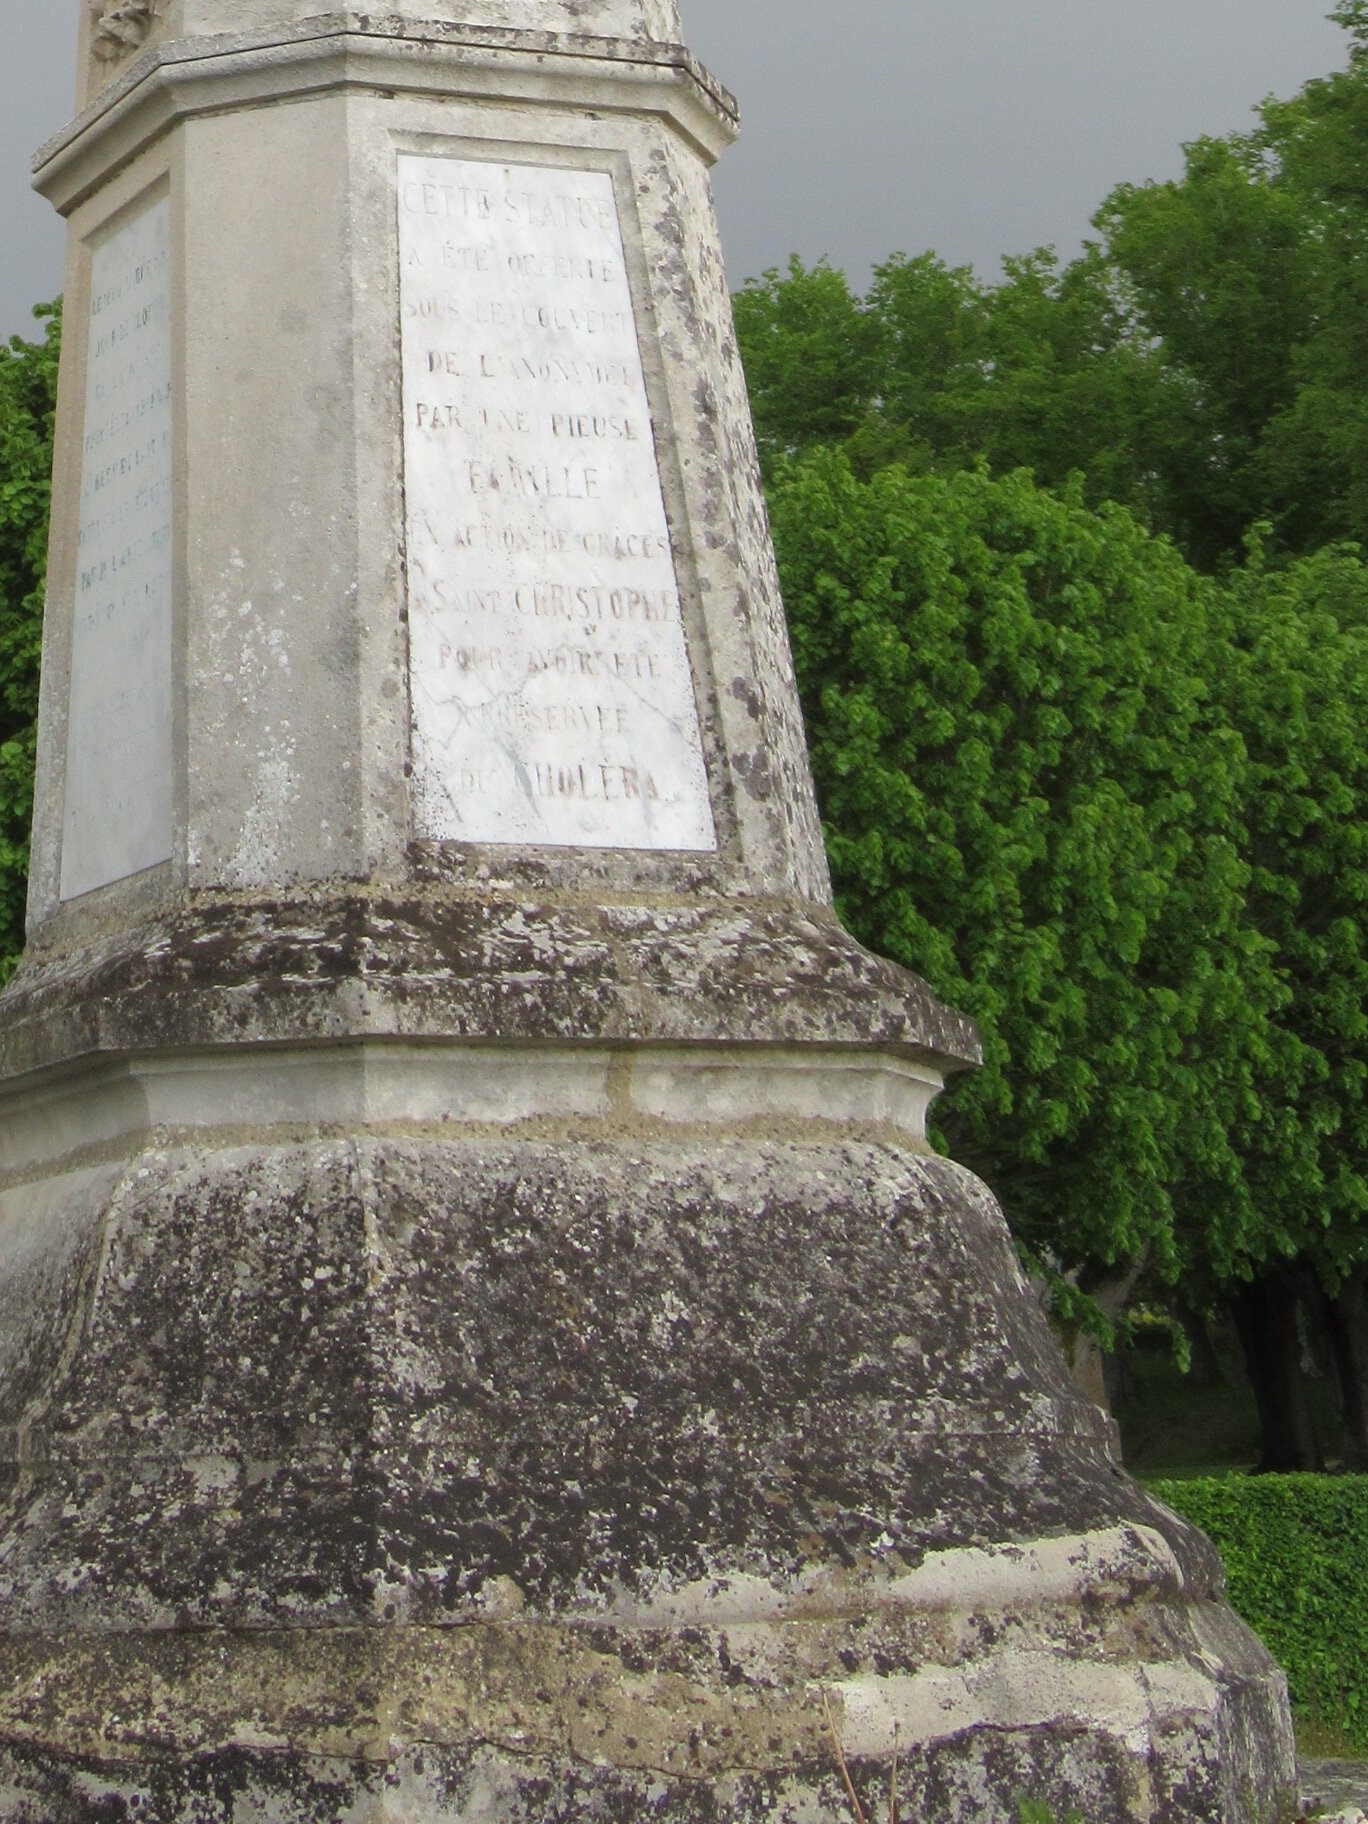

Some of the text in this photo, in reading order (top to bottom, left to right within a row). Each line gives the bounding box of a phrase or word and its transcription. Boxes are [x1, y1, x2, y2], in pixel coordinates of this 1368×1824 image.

[401, 182, 613, 231] CETTE STATUE
[407, 248, 424, 267] A
[507, 253, 616, 283] OFFERTE
[405, 297, 630, 335] SOUS LE COUVERT
[428, 351, 461, 377] DE
[416, 402, 637, 442] PAR UNE PIEUSE
[455, 524, 530, 551] ACTION
[541, 528, 570, 553] DE
[514, 582, 679, 623] CHRISTOPHE
[439, 643, 502, 672] POUR
[528, 648, 593, 675] AVOIR
[461, 768, 485, 793] DU
